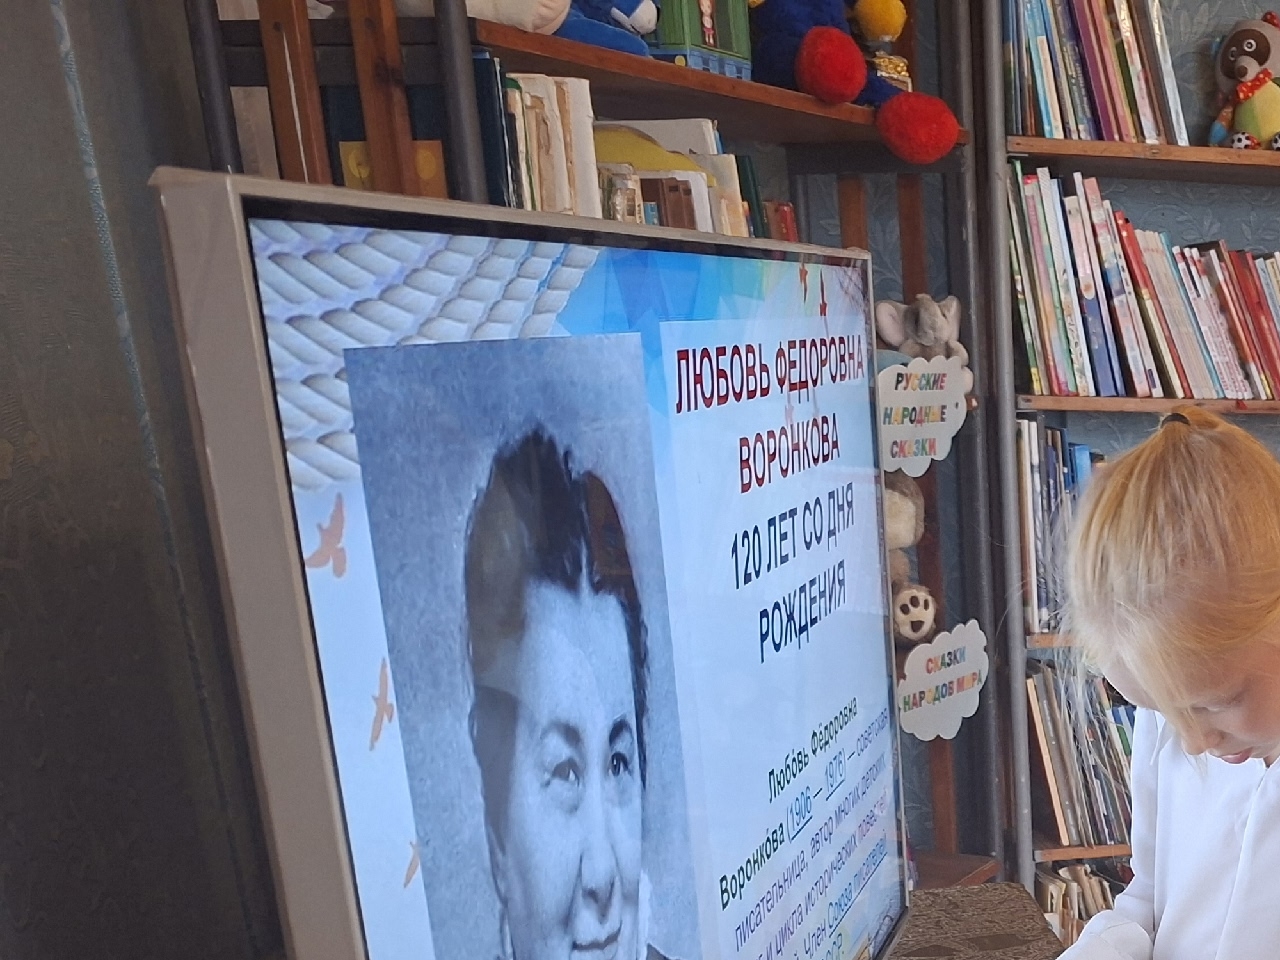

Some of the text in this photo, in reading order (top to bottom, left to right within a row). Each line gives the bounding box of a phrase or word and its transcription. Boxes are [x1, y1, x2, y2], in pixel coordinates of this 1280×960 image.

[676, 335, 865, 413] ЛЮБОВЬ ФЕДОРОВНА
[895, 372, 947, 392] РУССКИЕ
[739, 413, 840, 494] ВОРОНКОВА
[883, 405, 947, 426] НАРОДНЫЕ
[890, 437, 937, 458] СКАЗКИ
[731, 482, 854, 589] 120 ЛЕТ СО ДНЯ
[760, 559, 846, 663] РОЖДЕНИЯ
[903, 672, 983, 711] НАРОДОВ МИРА
[926, 647, 966, 674] СКАЗКИ
[811, 697, 857, 756] Фёдоровна
[786, 786, 813, 843] (1906
[824, 748, 847, 800] 1976)
[735, 847, 809, 952] писательница,
[810, 818, 833, 860] автор
[834, 787, 859, 828] многих
[774, 903, 803, 958] цикла
[804, 836, 857, 912] исторических
[804, 924, 826, 960] Член
[828, 885, 853, 937] Союза
